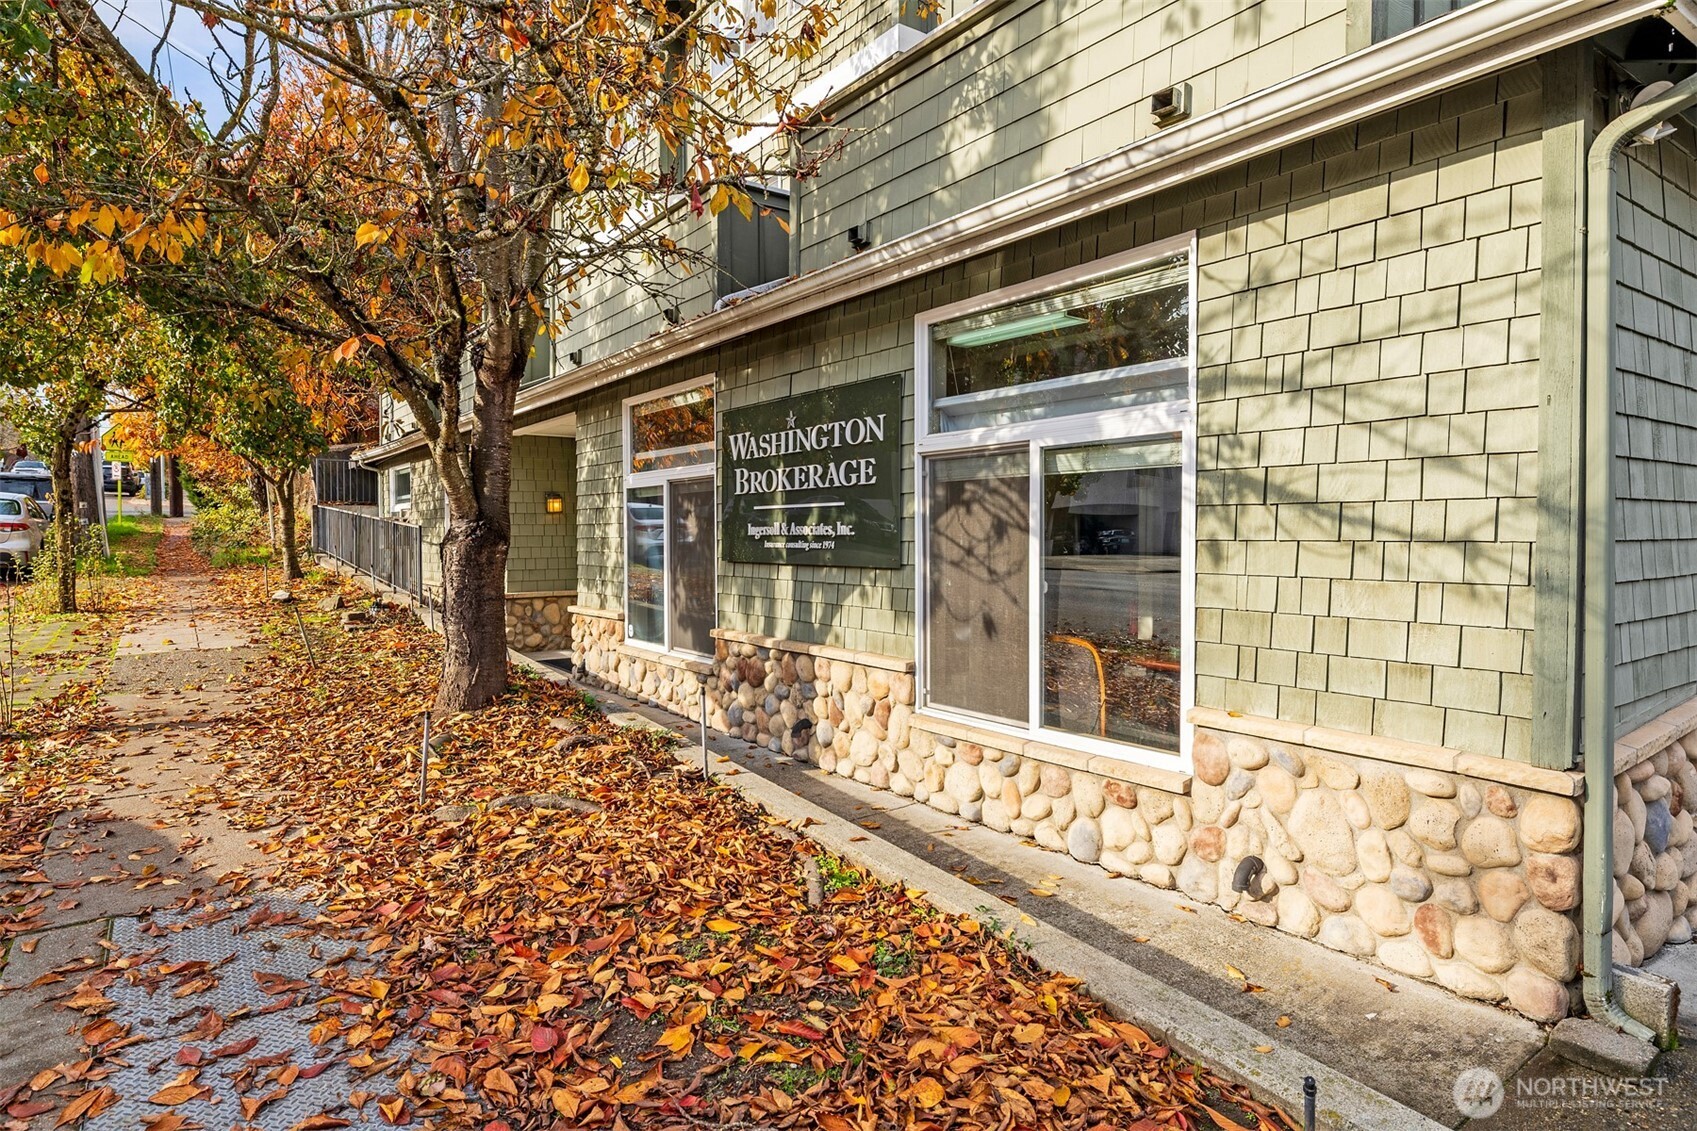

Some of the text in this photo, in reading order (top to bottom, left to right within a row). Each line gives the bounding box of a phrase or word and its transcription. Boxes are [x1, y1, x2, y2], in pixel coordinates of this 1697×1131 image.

[728, 414, 887, 461] WASHINGTON
[734, 457, 877, 495] BROKERAGE
[747, 521, 855, 539] Ingersoll & Associates, Inc.
[785, 540, 809, 551] consulting
[809, 541, 822, 549] since
[822, 541, 835, 549] 1974
